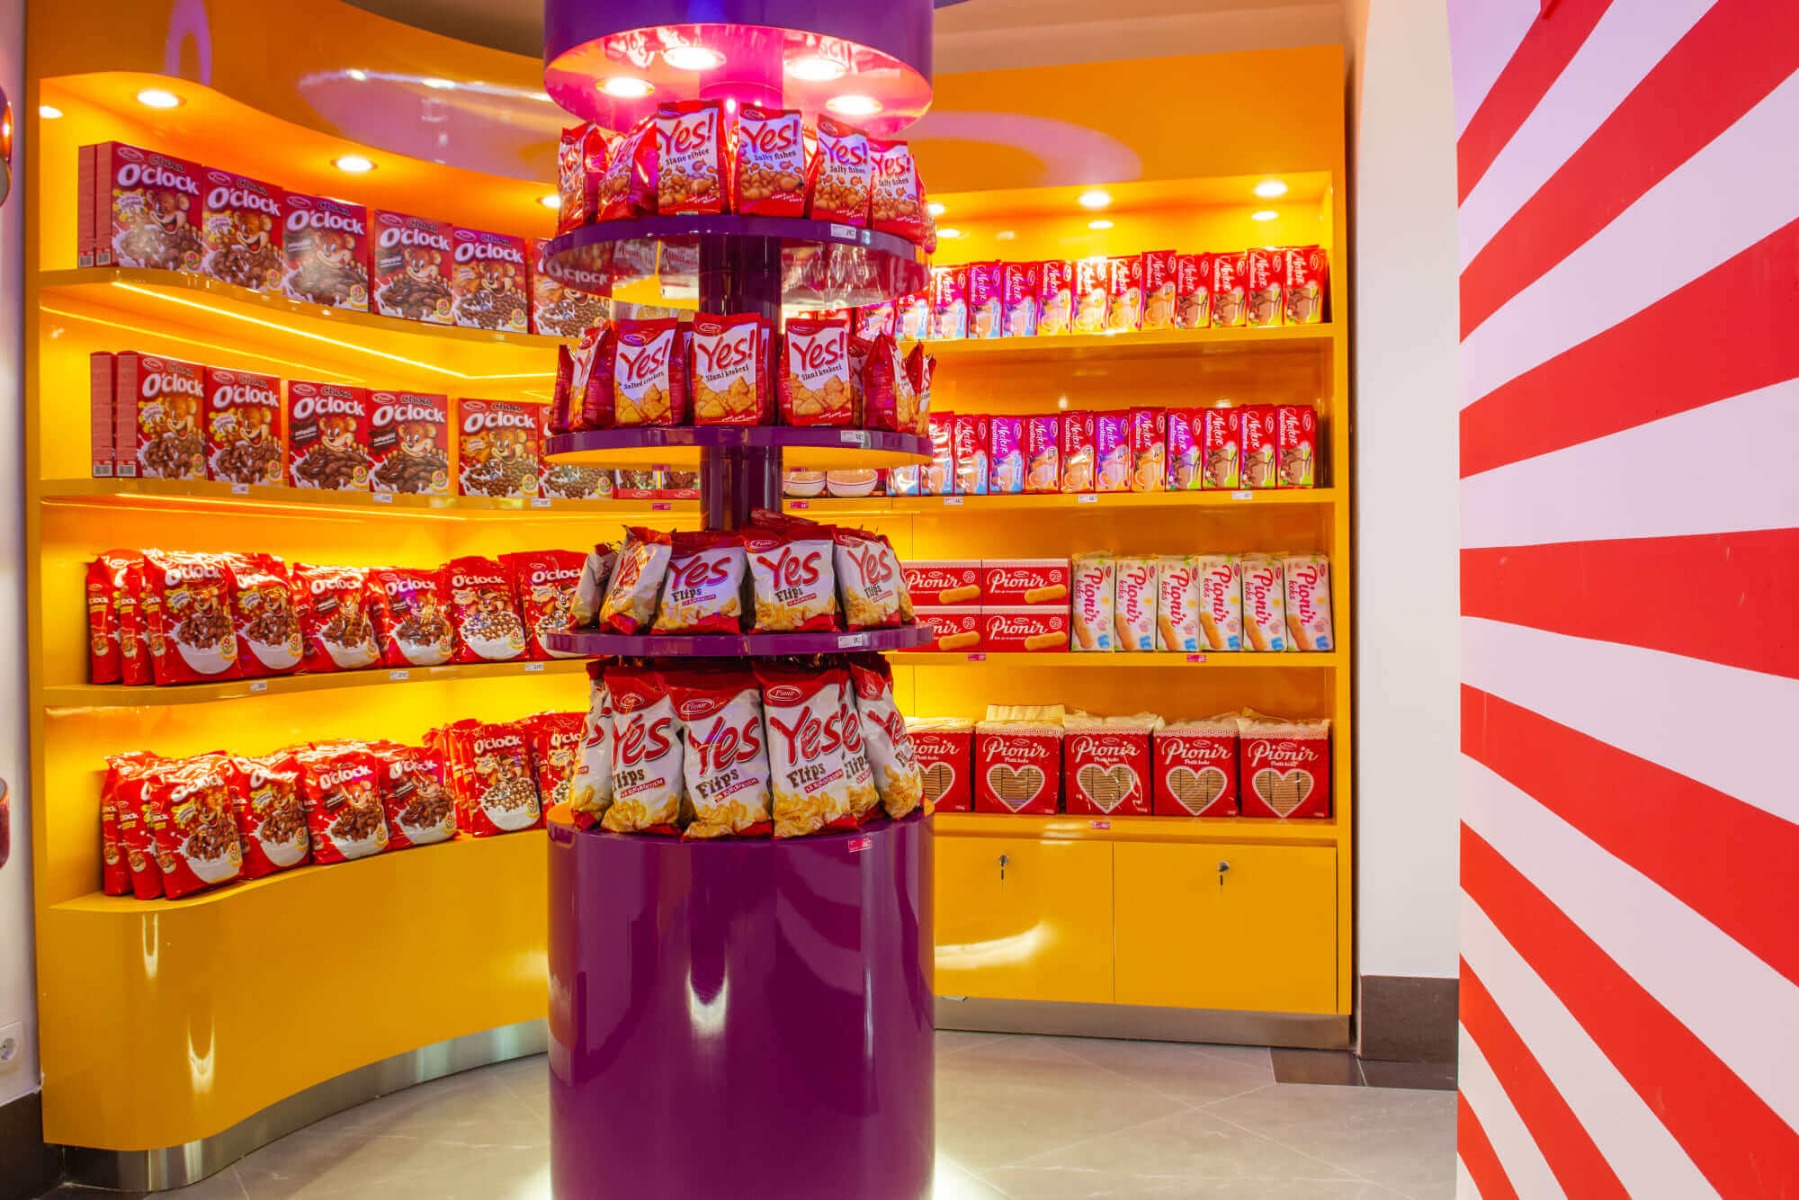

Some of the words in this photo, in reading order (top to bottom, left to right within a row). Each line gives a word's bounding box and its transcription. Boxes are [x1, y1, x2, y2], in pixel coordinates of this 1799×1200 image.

[657, 112, 714, 156] Yes!
[740, 119, 799, 154] Yes!
[754, 153, 773, 163] Salty
[774, 150, 797, 160] fishes
[819, 137, 868, 166] Yes!
[870, 153, 911, 178] Yes!
[117, 163, 200, 196] O'clock
[830, 165, 847, 175] Salty
[206, 185, 281, 217] O'clock
[286, 209, 364, 236] O'clock
[379, 227, 451, 252] O'clock
[454, 242, 524, 264] O'clock
[1011, 265, 1024, 301] Medene
[1048, 262, 1060, 295] Medene
[619, 338, 670, 381] Yes!
[698, 329, 756, 373] Yes!
[791, 331, 845, 372] Yes!
[142, 373, 204, 398] O'clock
[623, 380, 643, 391] Salted
[705, 372, 724, 383] Slani
[801, 370, 818, 381] Slani
[212, 385, 280, 408] O'clock
[293, 396, 366, 420] O'clock
[372, 404, 446, 427] O'clock
[463, 412, 536, 433] O'clock
[1210, 410, 1226, 446] Medene
[1246, 411, 1261, 448] Medene
[1285, 408, 1300, 446] Medene
[997, 418, 1011, 453] Medene
[1033, 418, 1047, 451] Medene
[1069, 416, 1083, 450] Medene
[1104, 416, 1118, 449] Medene
[1139, 412, 1153, 448] Medene
[1175, 413, 1190, 450] Medene
[668, 555, 731, 591] Yes
[757, 547, 821, 590] Yes
[848, 545, 893, 588] Yes
[904, 569, 962, 590] Pionir
[385, 579, 438, 596] O'clock
[452, 574, 506, 588] O'clock
[671, 588, 702, 602] Flips
[774, 586, 803, 602] Flips
[864, 583, 883, 599] Flips
[986, 568, 1048, 594] Pionir
[1117, 580, 1127, 599] keks
[1161, 581, 1170, 600] keks
[1203, 578, 1213, 598] keks
[1212, 565, 1232, 624] Pionir
[1245, 581, 1254, 601] keks
[1288, 580, 1298, 600] keks
[1083, 568, 1103, 624] Pionir
[1126, 567, 1146, 625] Pionir
[1170, 568, 1189, 627] Pionir
[1254, 568, 1272, 626] Pionir
[1297, 566, 1317, 625] Pionir
[986, 615, 1048, 641] Pionir
[474, 735, 523, 755] O'clock
[551, 732, 581, 746] O'clo
[612, 713, 671, 769] Yes
[688, 716, 761, 776] Yes
[770, 705, 841, 766] Yes
[983, 735, 1050, 763] Pionir
[1071, 735, 1141, 763] Pionir
[1162, 737, 1232, 765] Pionir
[1248, 739, 1319, 767] Pionir
[320, 765, 374, 790] O'clock
[389, 759, 438, 780] O'clock
[786, 762, 827, 789] Flips
[695, 768, 740, 800] Flips
